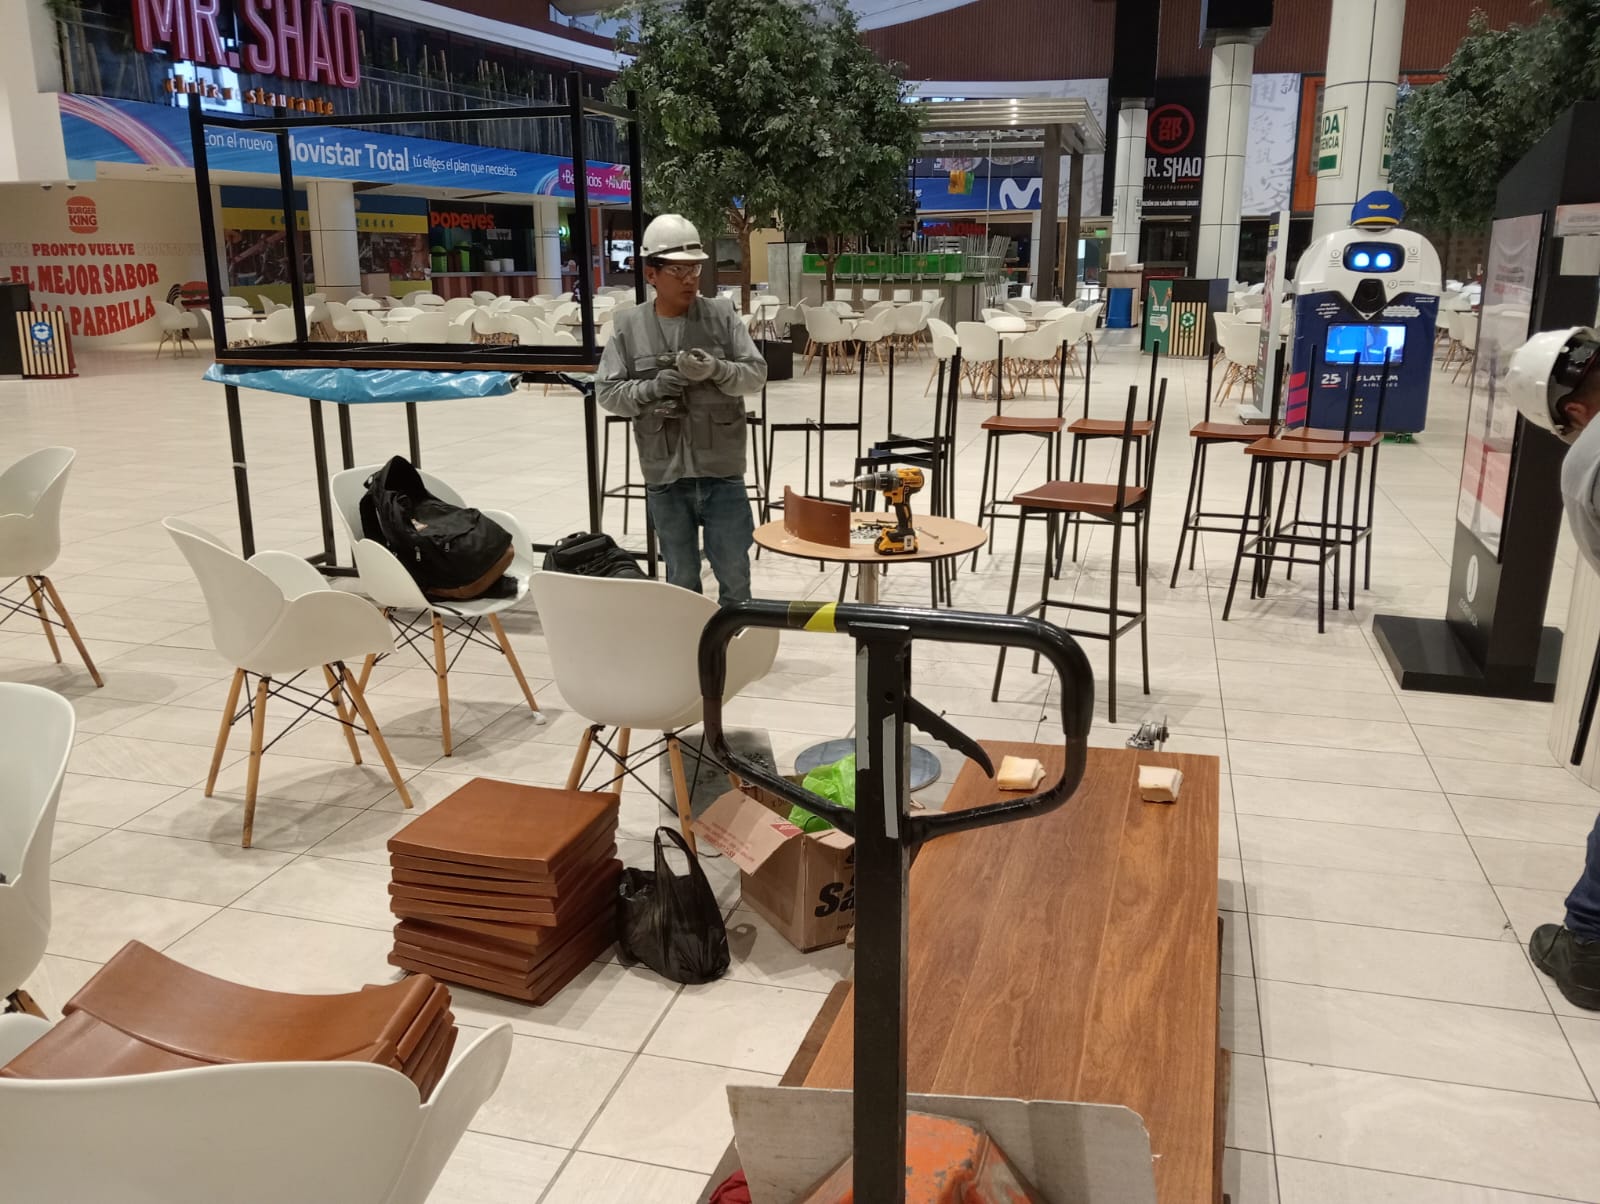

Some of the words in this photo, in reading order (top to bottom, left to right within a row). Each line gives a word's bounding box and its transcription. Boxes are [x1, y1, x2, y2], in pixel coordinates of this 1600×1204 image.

[227, 132, 237, 149] el
[239, 136, 274, 152] nuevo
[364, 143, 409, 172] Total
[412, 154, 423, 168] tú
[423, 155, 446, 174] eliges
[447, 157, 453, 171] el
[453, 159, 471, 176] plan
[471, 163, 485, 178] que
[485, 164, 518, 178] necesitas
[1163, 157, 1202, 183] SHAO
[67, 206, 97, 215] BURGER
[69, 215, 98, 226] KING
[31, 243, 87, 257] PRONTO
[88, 243, 136, 256] VUELVE
[10, 265, 36, 292] EL
[37, 264, 103, 296] MEJOR
[103, 263, 160, 294] SABOR
[68, 295, 157, 337] PARRILLA
